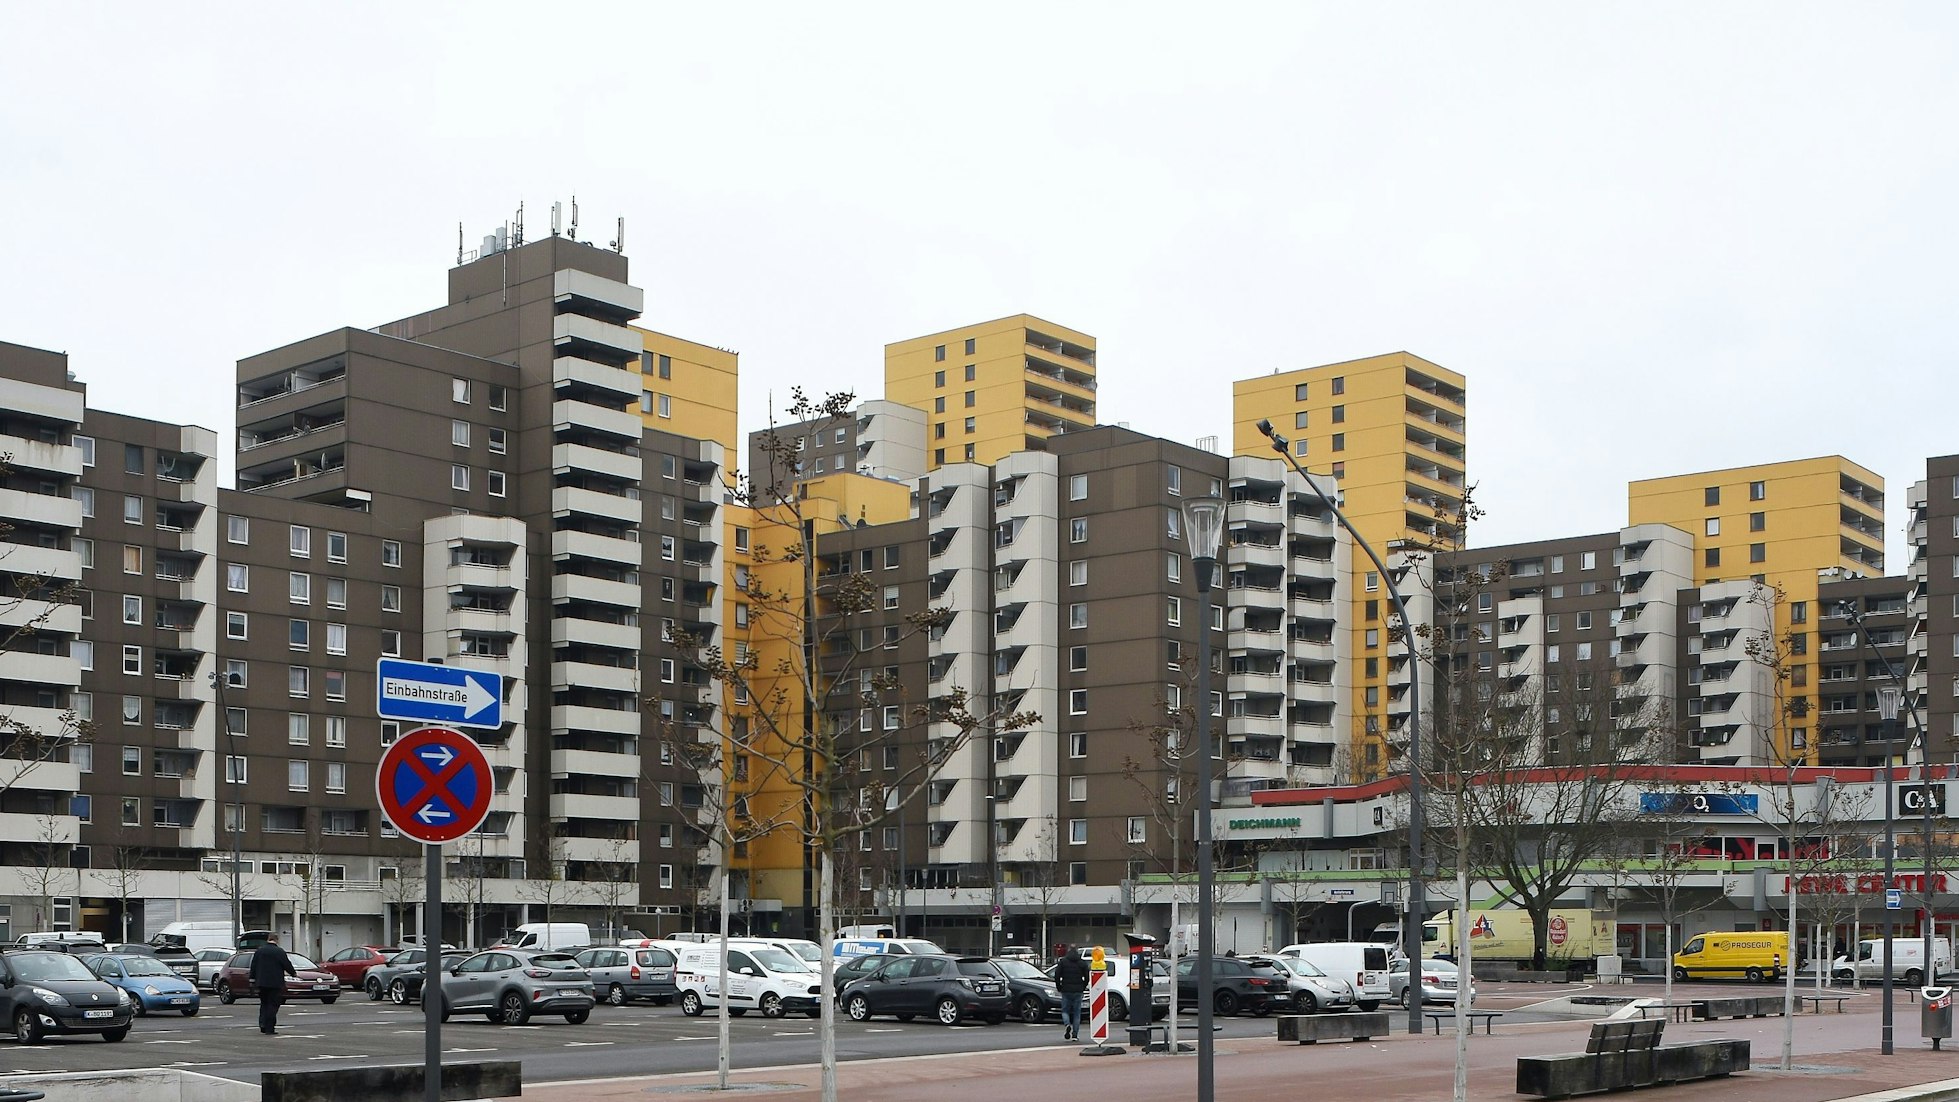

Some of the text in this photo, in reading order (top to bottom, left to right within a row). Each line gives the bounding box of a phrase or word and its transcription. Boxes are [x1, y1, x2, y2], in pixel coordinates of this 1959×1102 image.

[386, 682, 468, 702] Einbahnstraße
[1904, 790, 1939, 809] C&A
[1229, 817, 1302, 830] DEICHMANN
[1473, 920, 1494, 929] L&T
[1731, 941, 1772, 949] PROSEGUR
[1131, 954, 1138, 964] P
